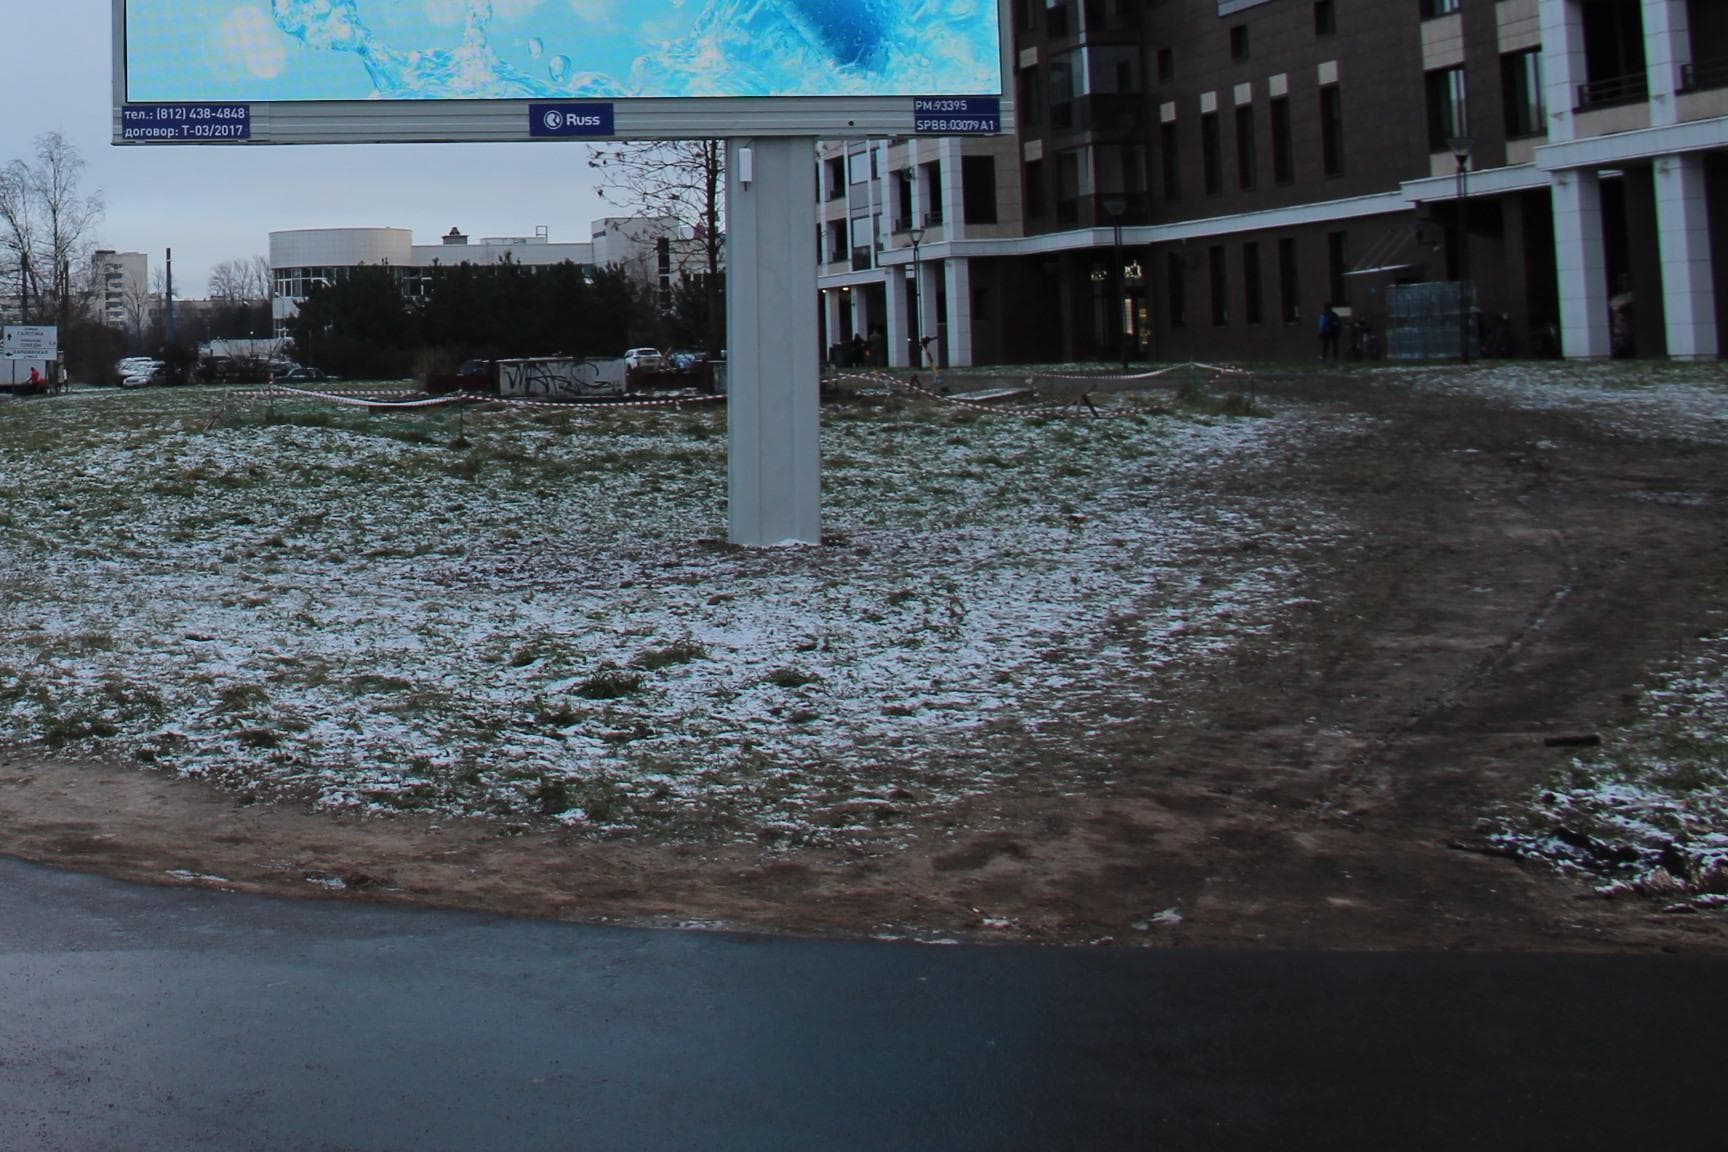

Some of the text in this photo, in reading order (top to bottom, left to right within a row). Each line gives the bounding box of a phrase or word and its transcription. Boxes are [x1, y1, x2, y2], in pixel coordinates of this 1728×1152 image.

[125, 107, 245, 120] тел.: (812) 438-4848
[566, 113, 600, 125] Russ
[124, 124, 243, 138] договор: Т-03/2017
